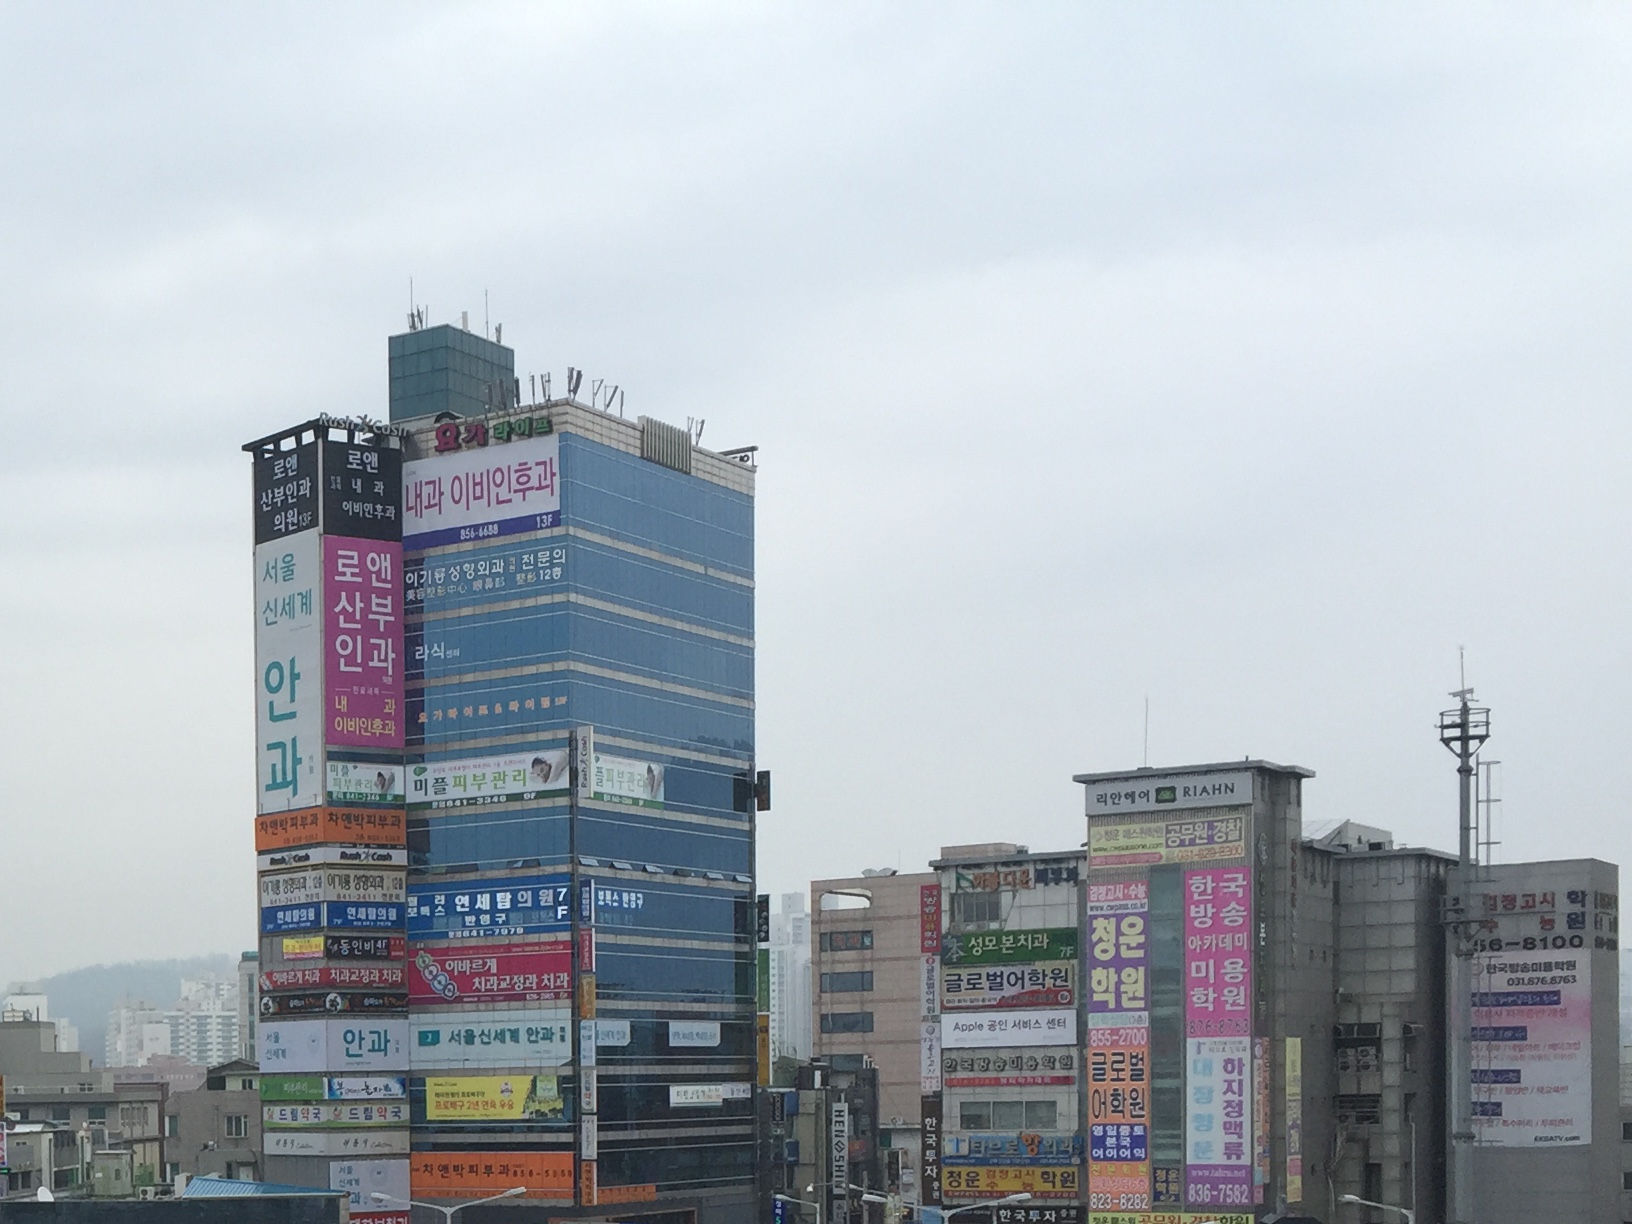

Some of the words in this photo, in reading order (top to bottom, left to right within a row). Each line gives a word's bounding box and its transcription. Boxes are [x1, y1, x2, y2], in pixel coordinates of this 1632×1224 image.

[319, 412, 356, 429] Rush
[372, 422, 409, 438] Cash
[435, 422, 487, 452] 요가
[493, 416, 552, 440] 라이프
[273, 453, 298, 479] 로앤
[347, 450, 379, 474] 로앤
[260, 476, 312, 511] 산부인과
[405, 477, 444, 518] 내과
[451, 457, 556, 510] 이비인후과
[342, 501, 396, 520] 이비인후과
[536, 514, 553, 528] 13F
[263, 553, 295, 583] 서울
[334, 550, 392, 588] 로앤
[522, 549, 566, 569] 전문의
[263, 589, 312, 626] 신세계
[415, 642, 444, 661] 라식
[335, 717, 395, 736] 이비인후과
[414, 777, 448, 796] 미플
[452, 769, 527, 792] 피부관리
[1096, 789, 1150, 806] 리안헤어
[1183, 783, 1235, 797] RIAHN
[293, 853, 310, 863] Cash
[340, 851, 362, 861] Rush
[371, 852, 392, 862] Cash
[1189, 873, 1248, 900] 한국
[1190, 901, 1247, 929] 방송
[969, 933, 1049, 956] 성모본치과
[1059, 947, 1074, 957] 7F
[1091, 915, 1145, 961] 청운
[1188, 932, 1248, 952] 아카데미
[330, 969, 379, 983] 치과교정과
[382, 970, 402, 982] 치과
[472, 975, 538, 991] 치과교정과
[541, 973, 569, 989] 치과
[944, 967, 1069, 993] 글로벌어학원
[1191, 958, 1248, 983] 미용
[1091, 967, 1146, 1009] 학원
[1190, 986, 1246, 1011] 학원
[526, 1026, 555, 1043] 안과
[953, 1021, 984, 1032] Apple
[988, 1020, 1007, 1031] 공인
[1011, 1019, 1042, 1030] 서비스
[1046, 1018, 1067, 1029] 센터
[343, 1029, 390, 1058] 안과
[1090, 1029, 1147, 1046] 855-2700
[1091, 1051, 1145, 1083] 글로벌
[279, 1108, 322, 1121] 드림약국
[349, 1106, 402, 1121] 드림약국
[1091, 1087, 1146, 1119] 어학원
[925, 1117, 938, 1178] 한국투자
[947, 1171, 980, 1189] 청운
[1041, 1171, 1076, 1189] 학원
[1090, 1194, 1149, 1209] 823-8282
[1188, 1184, 1249, 1204] 836-7582
[999, 1209, 1057, 1223] 한국투자
